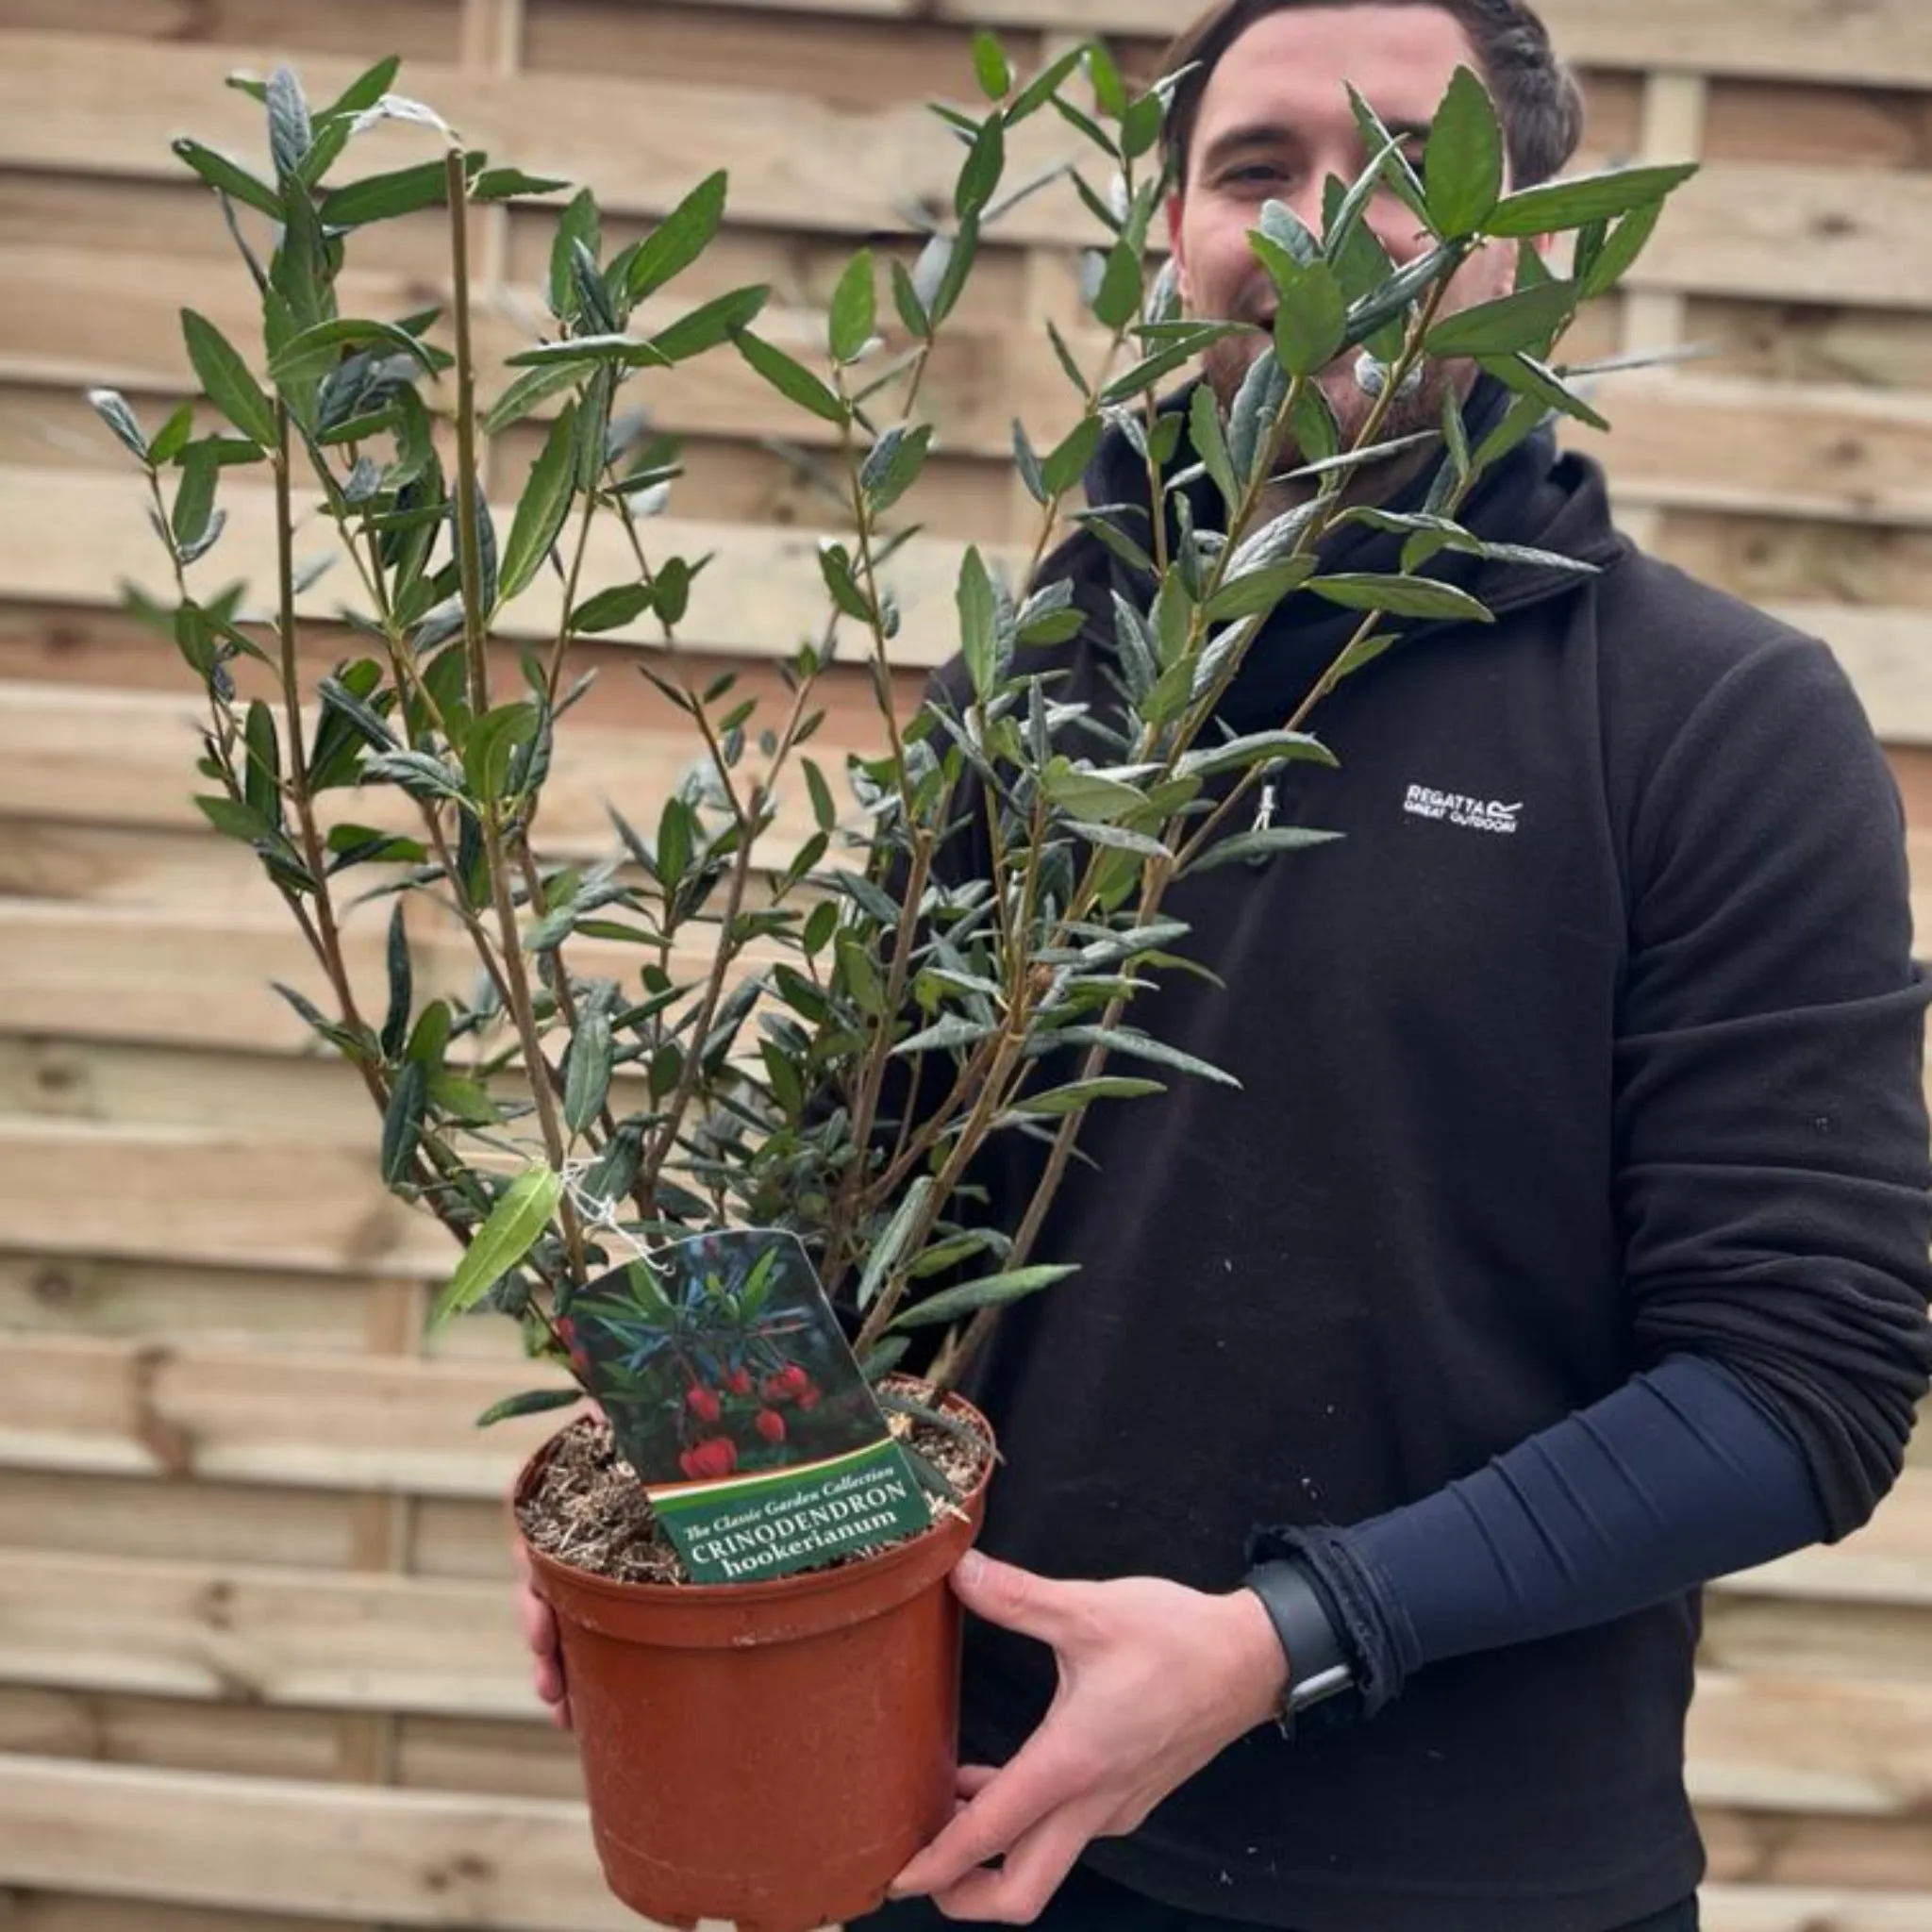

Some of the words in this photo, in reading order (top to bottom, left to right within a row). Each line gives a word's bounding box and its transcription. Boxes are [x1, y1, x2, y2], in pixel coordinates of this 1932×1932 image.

[1407, 785, 1485, 816] REGATTA
[684, 1524, 710, 1541] The
[713, 1509, 762, 1531] Classic
[764, 1491, 820, 1515] Garden
[822, 1467, 894, 1496] Collection
[691, 1480, 907, 1564] CRINODENDRON
[721, 1510, 897, 1577] hookerianum
